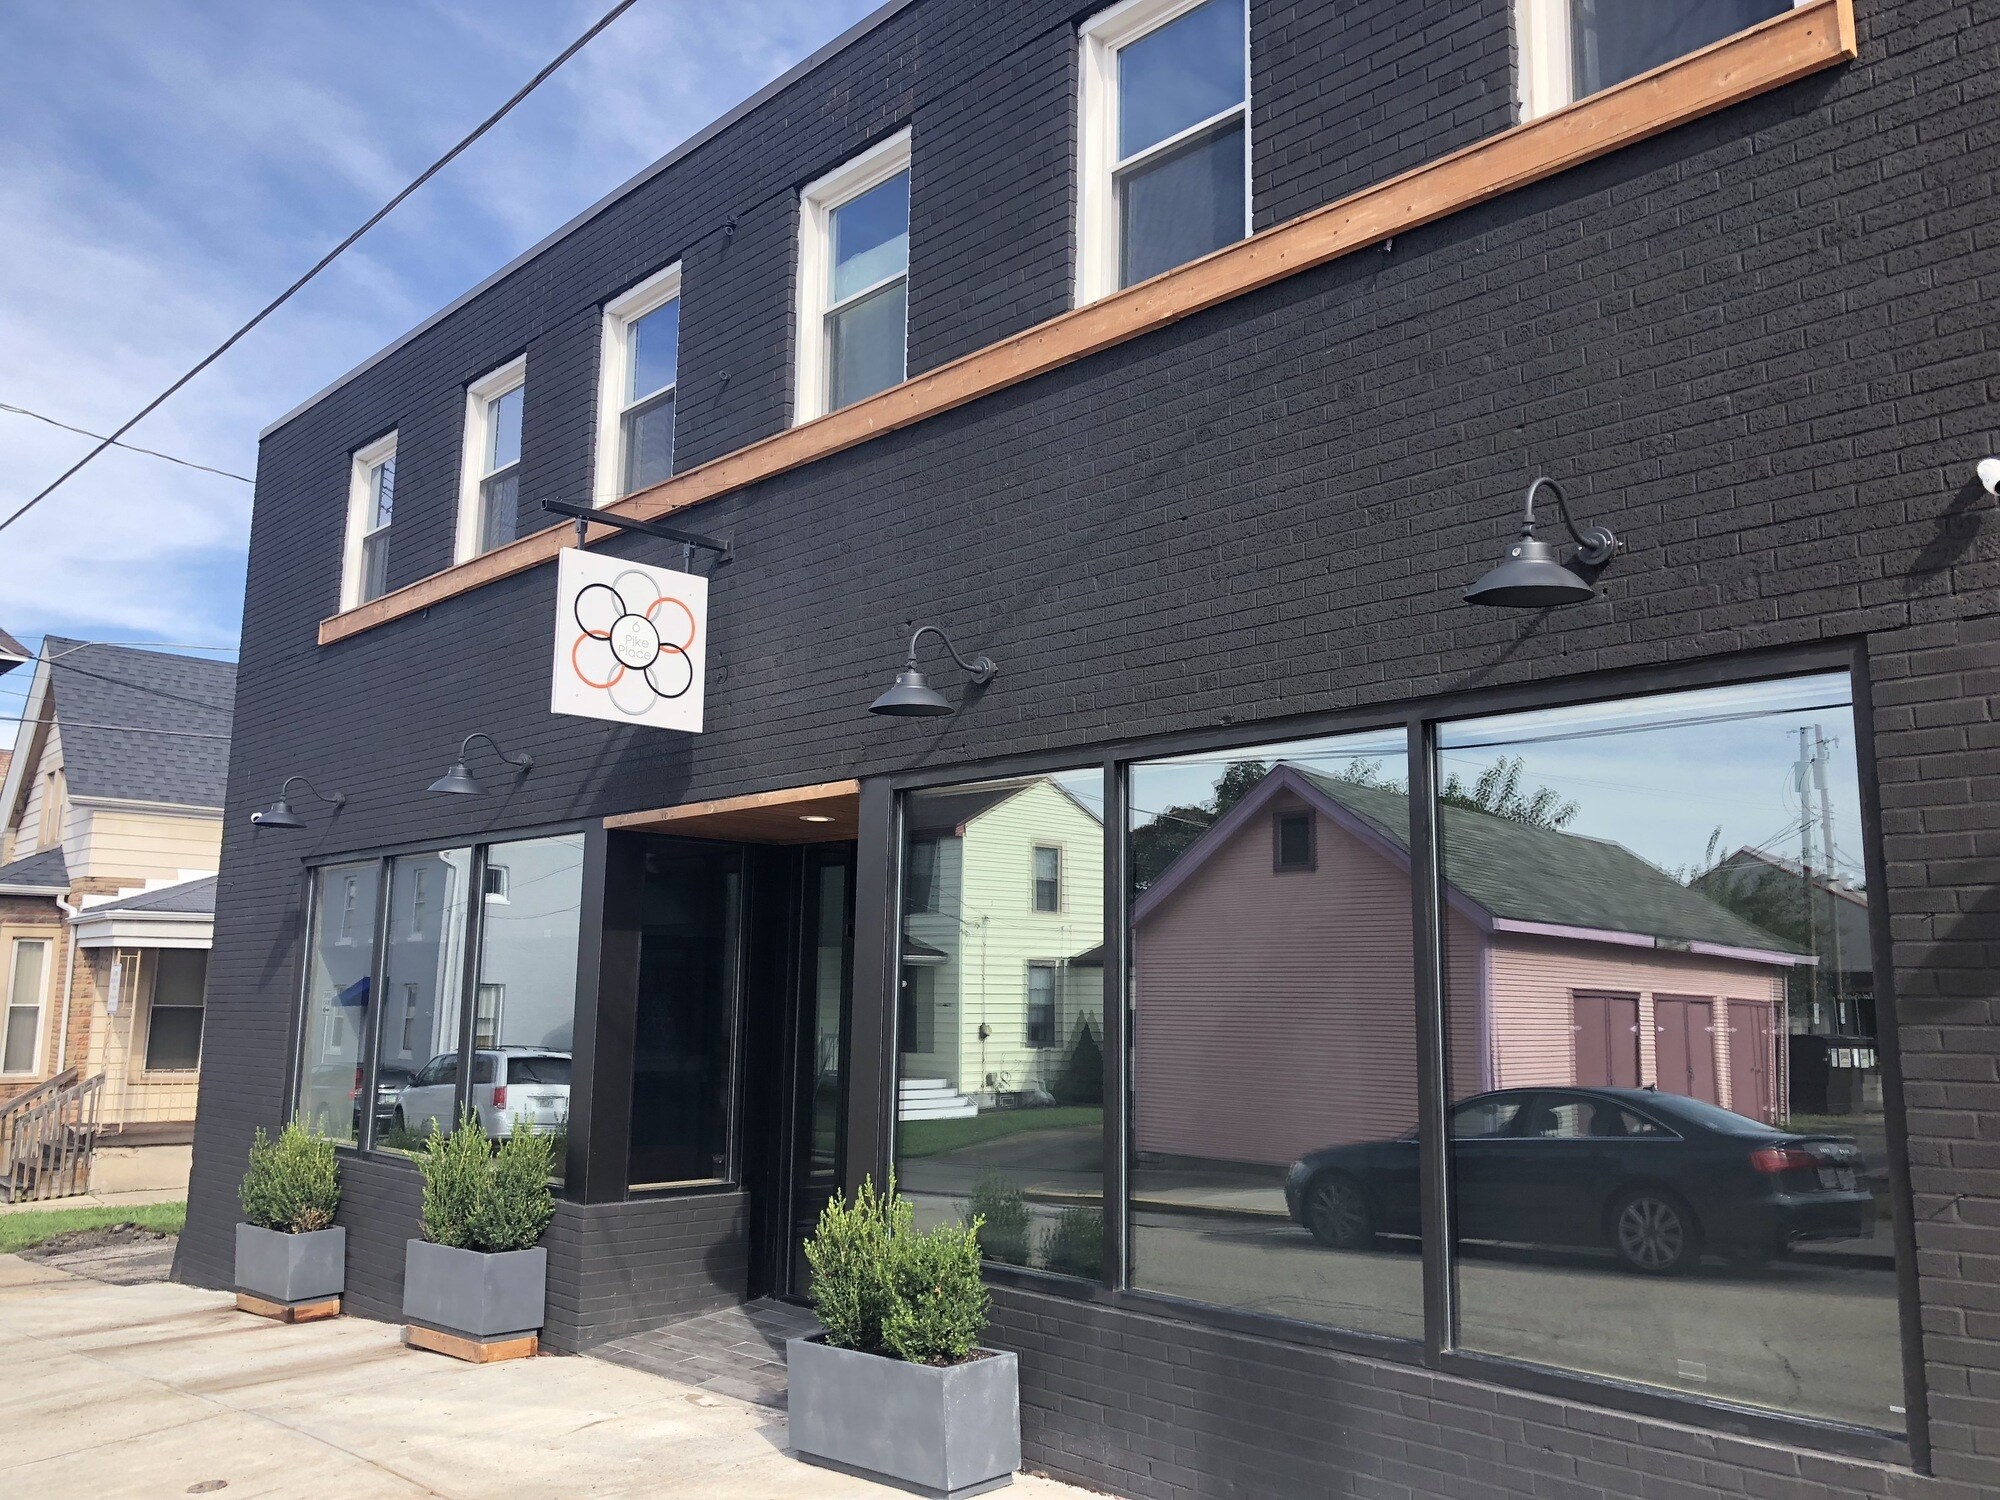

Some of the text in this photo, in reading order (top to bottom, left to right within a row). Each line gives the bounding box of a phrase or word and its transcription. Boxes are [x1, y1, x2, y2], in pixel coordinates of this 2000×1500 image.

[631, 621, 641, 633] 6
[625, 634, 650, 649] Pike
[618, 644, 652, 660] Place
